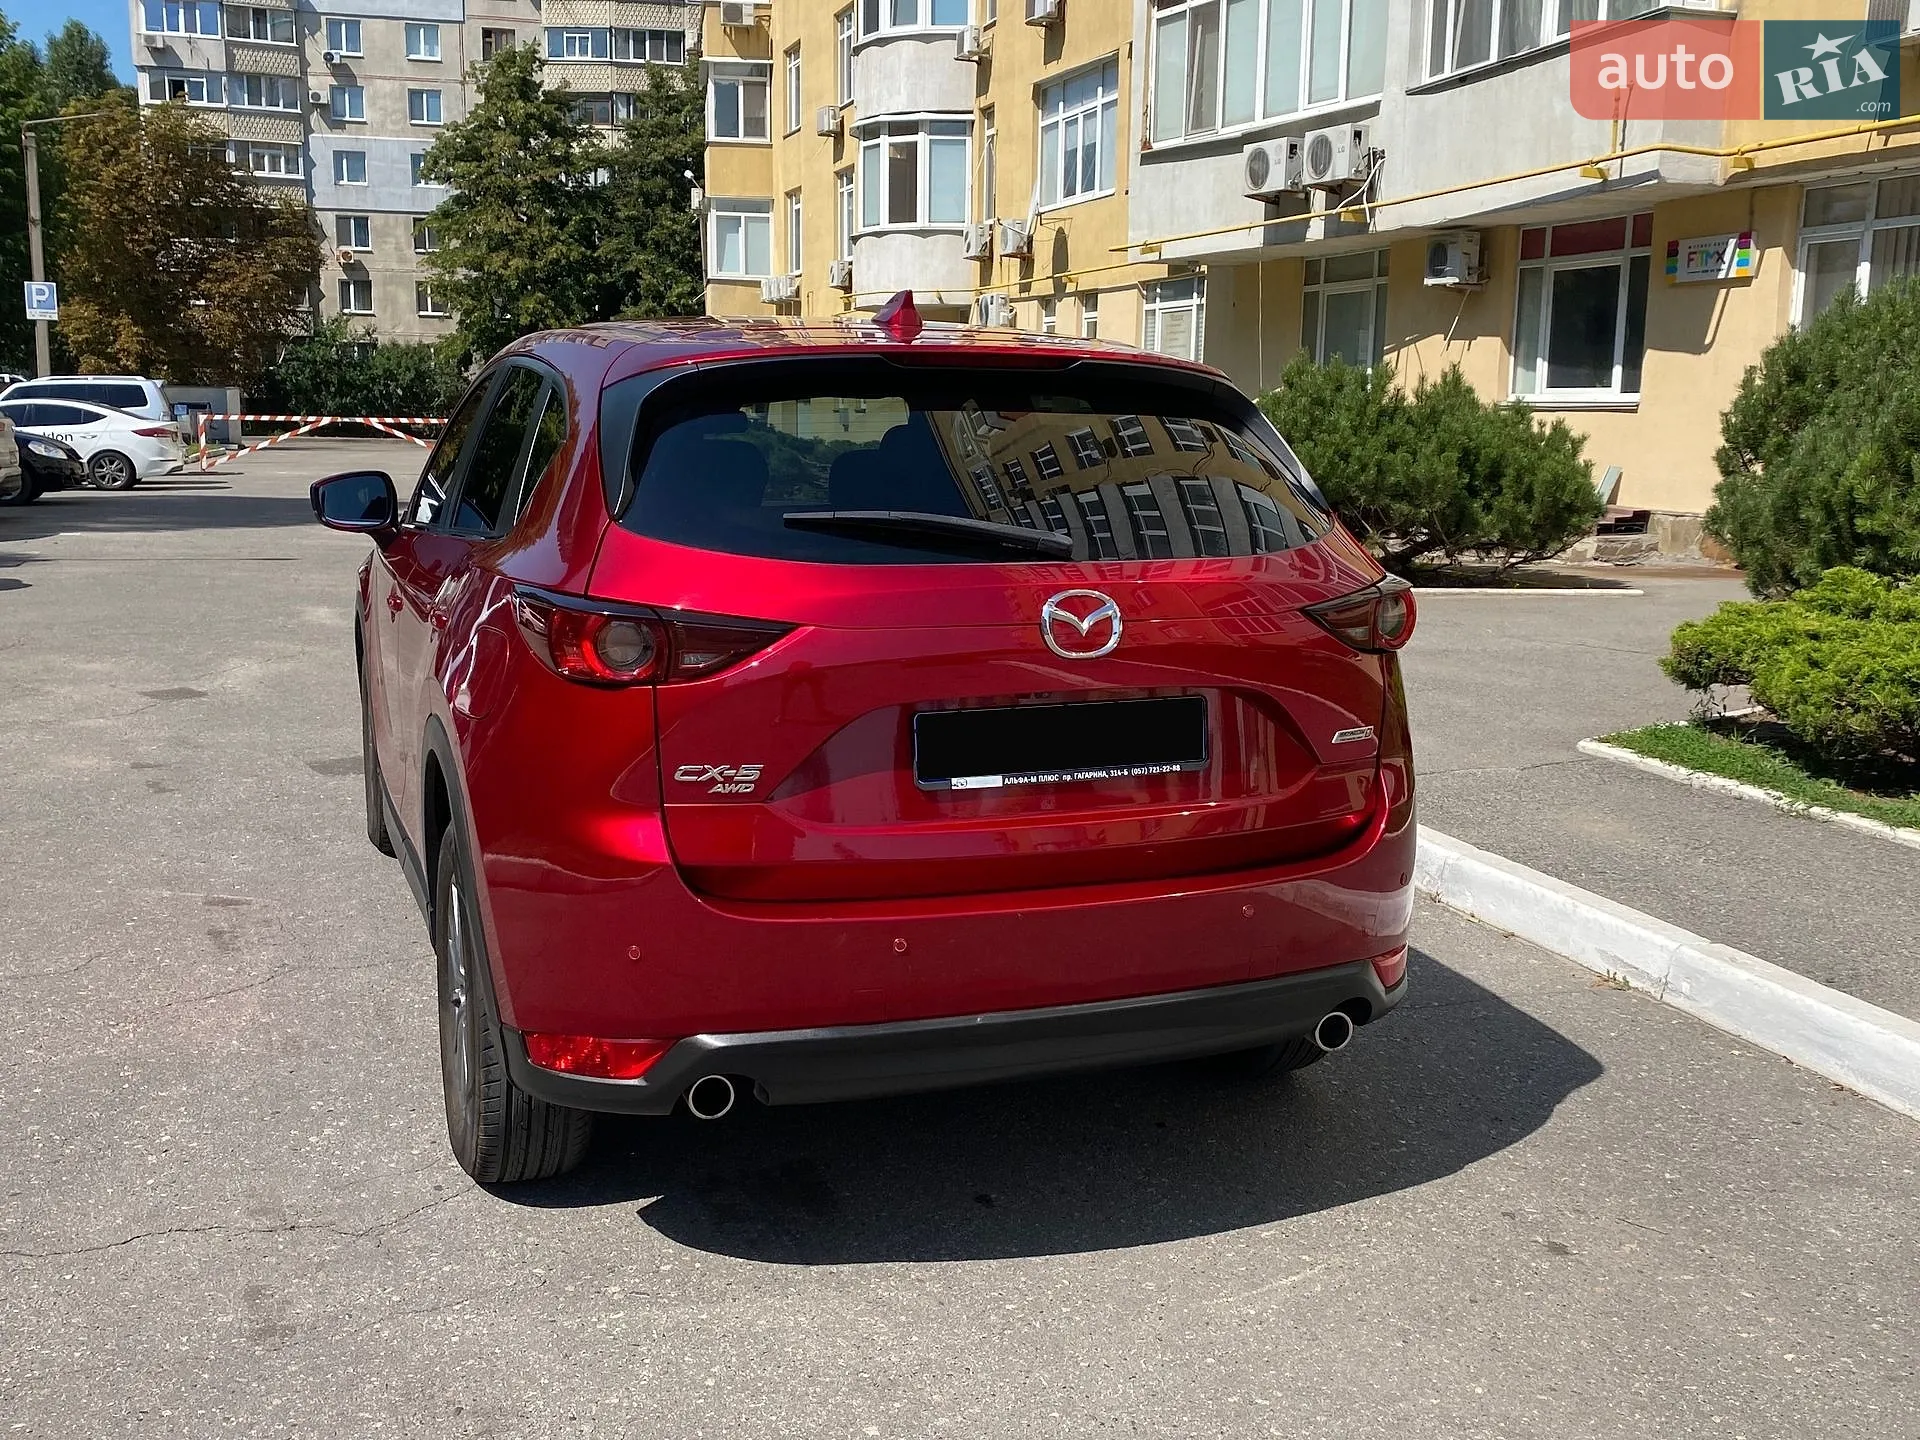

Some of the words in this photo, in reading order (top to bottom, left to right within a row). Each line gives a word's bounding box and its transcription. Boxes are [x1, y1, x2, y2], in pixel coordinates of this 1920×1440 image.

[31, 284, 50, 308] P
[674, 764, 764, 782] CX-5
[1004, 776, 1036, 785] АЛЬФА-М
[1038, 774, 1059, 782] ПЛЮС
[1074, 770, 1108, 779] ГАГАРИНА,
[1131, 767, 1147, 776] (057)
[707, 783, 755, 794] AWD
